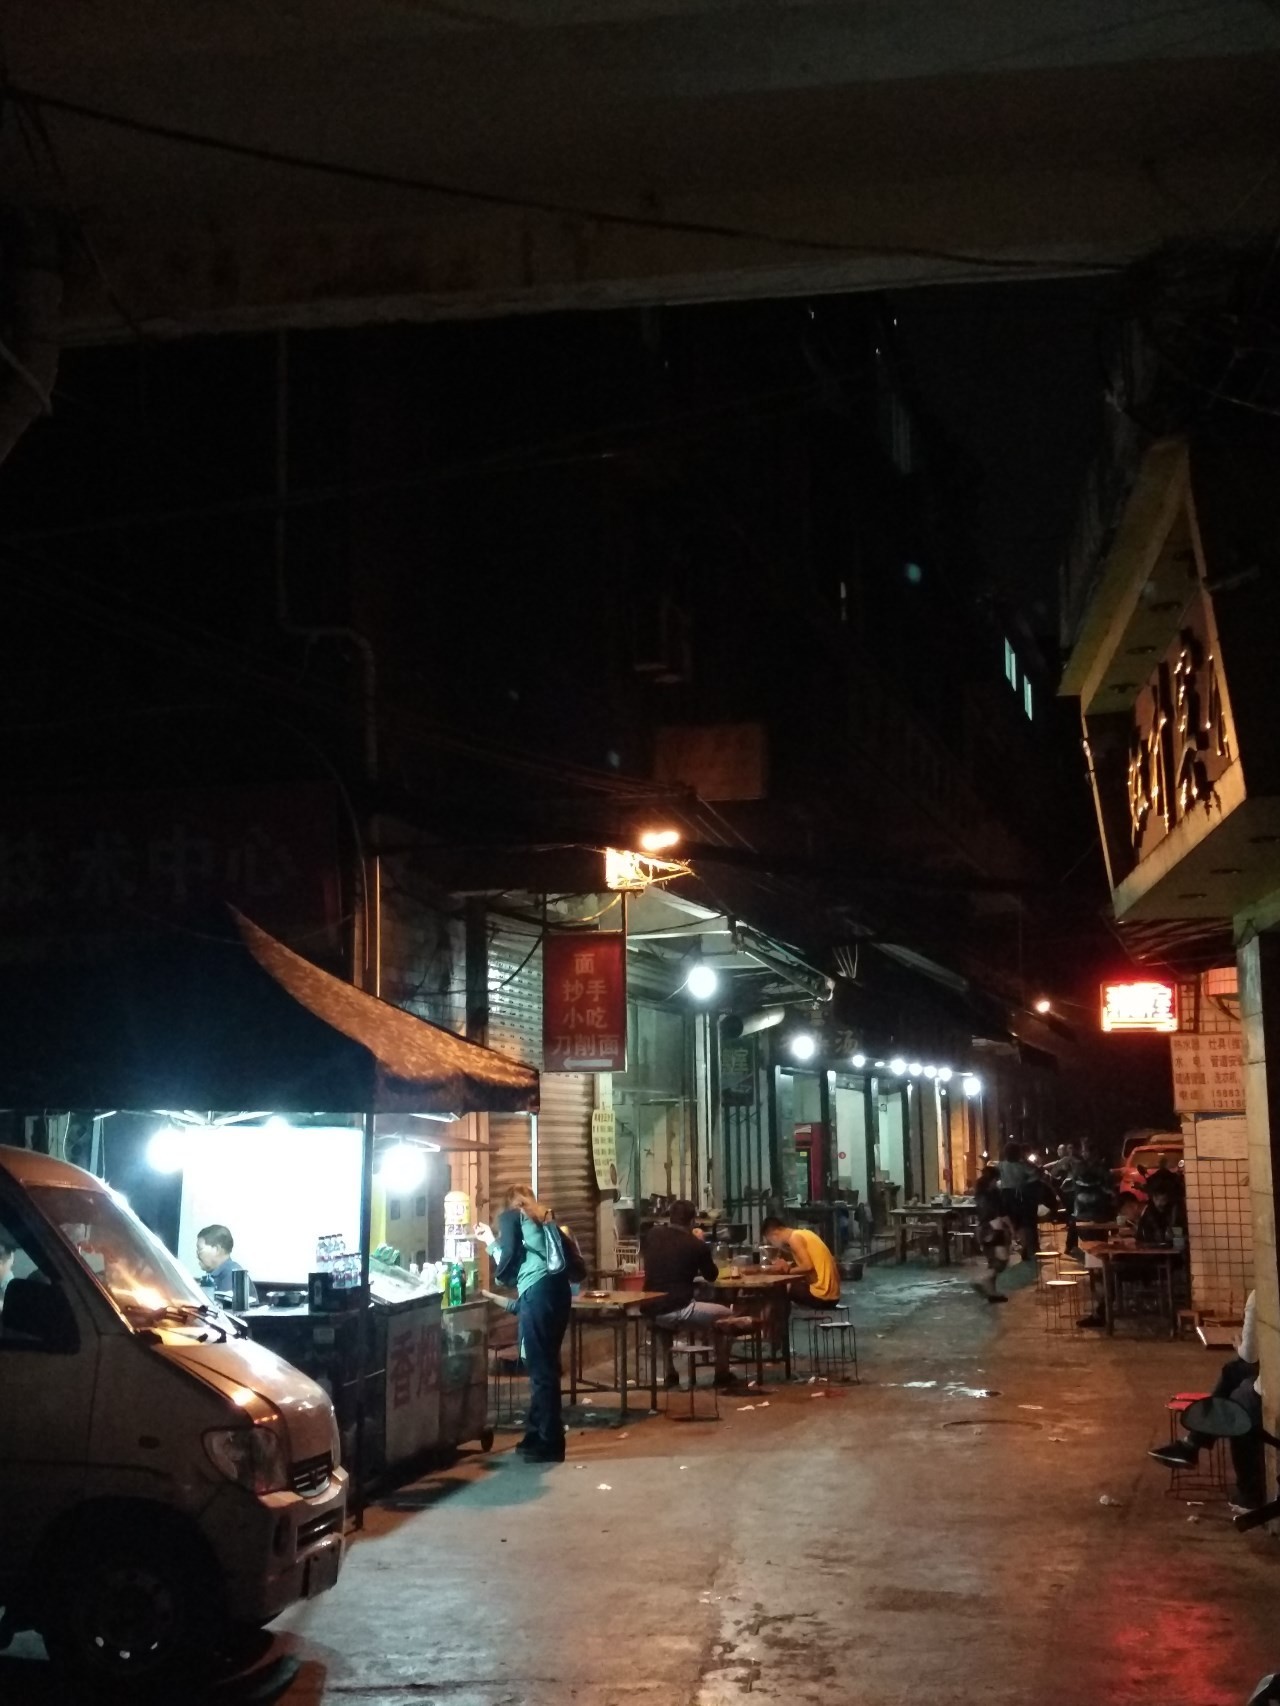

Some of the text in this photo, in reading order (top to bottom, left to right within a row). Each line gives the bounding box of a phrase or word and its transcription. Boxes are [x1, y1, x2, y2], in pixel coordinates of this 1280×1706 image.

[574, 953, 596, 975] 面
[562, 979, 608, 1003] 抄手
[563, 1007, 608, 1030] 小吃
[551, 1033, 620, 1057] 刀削面
